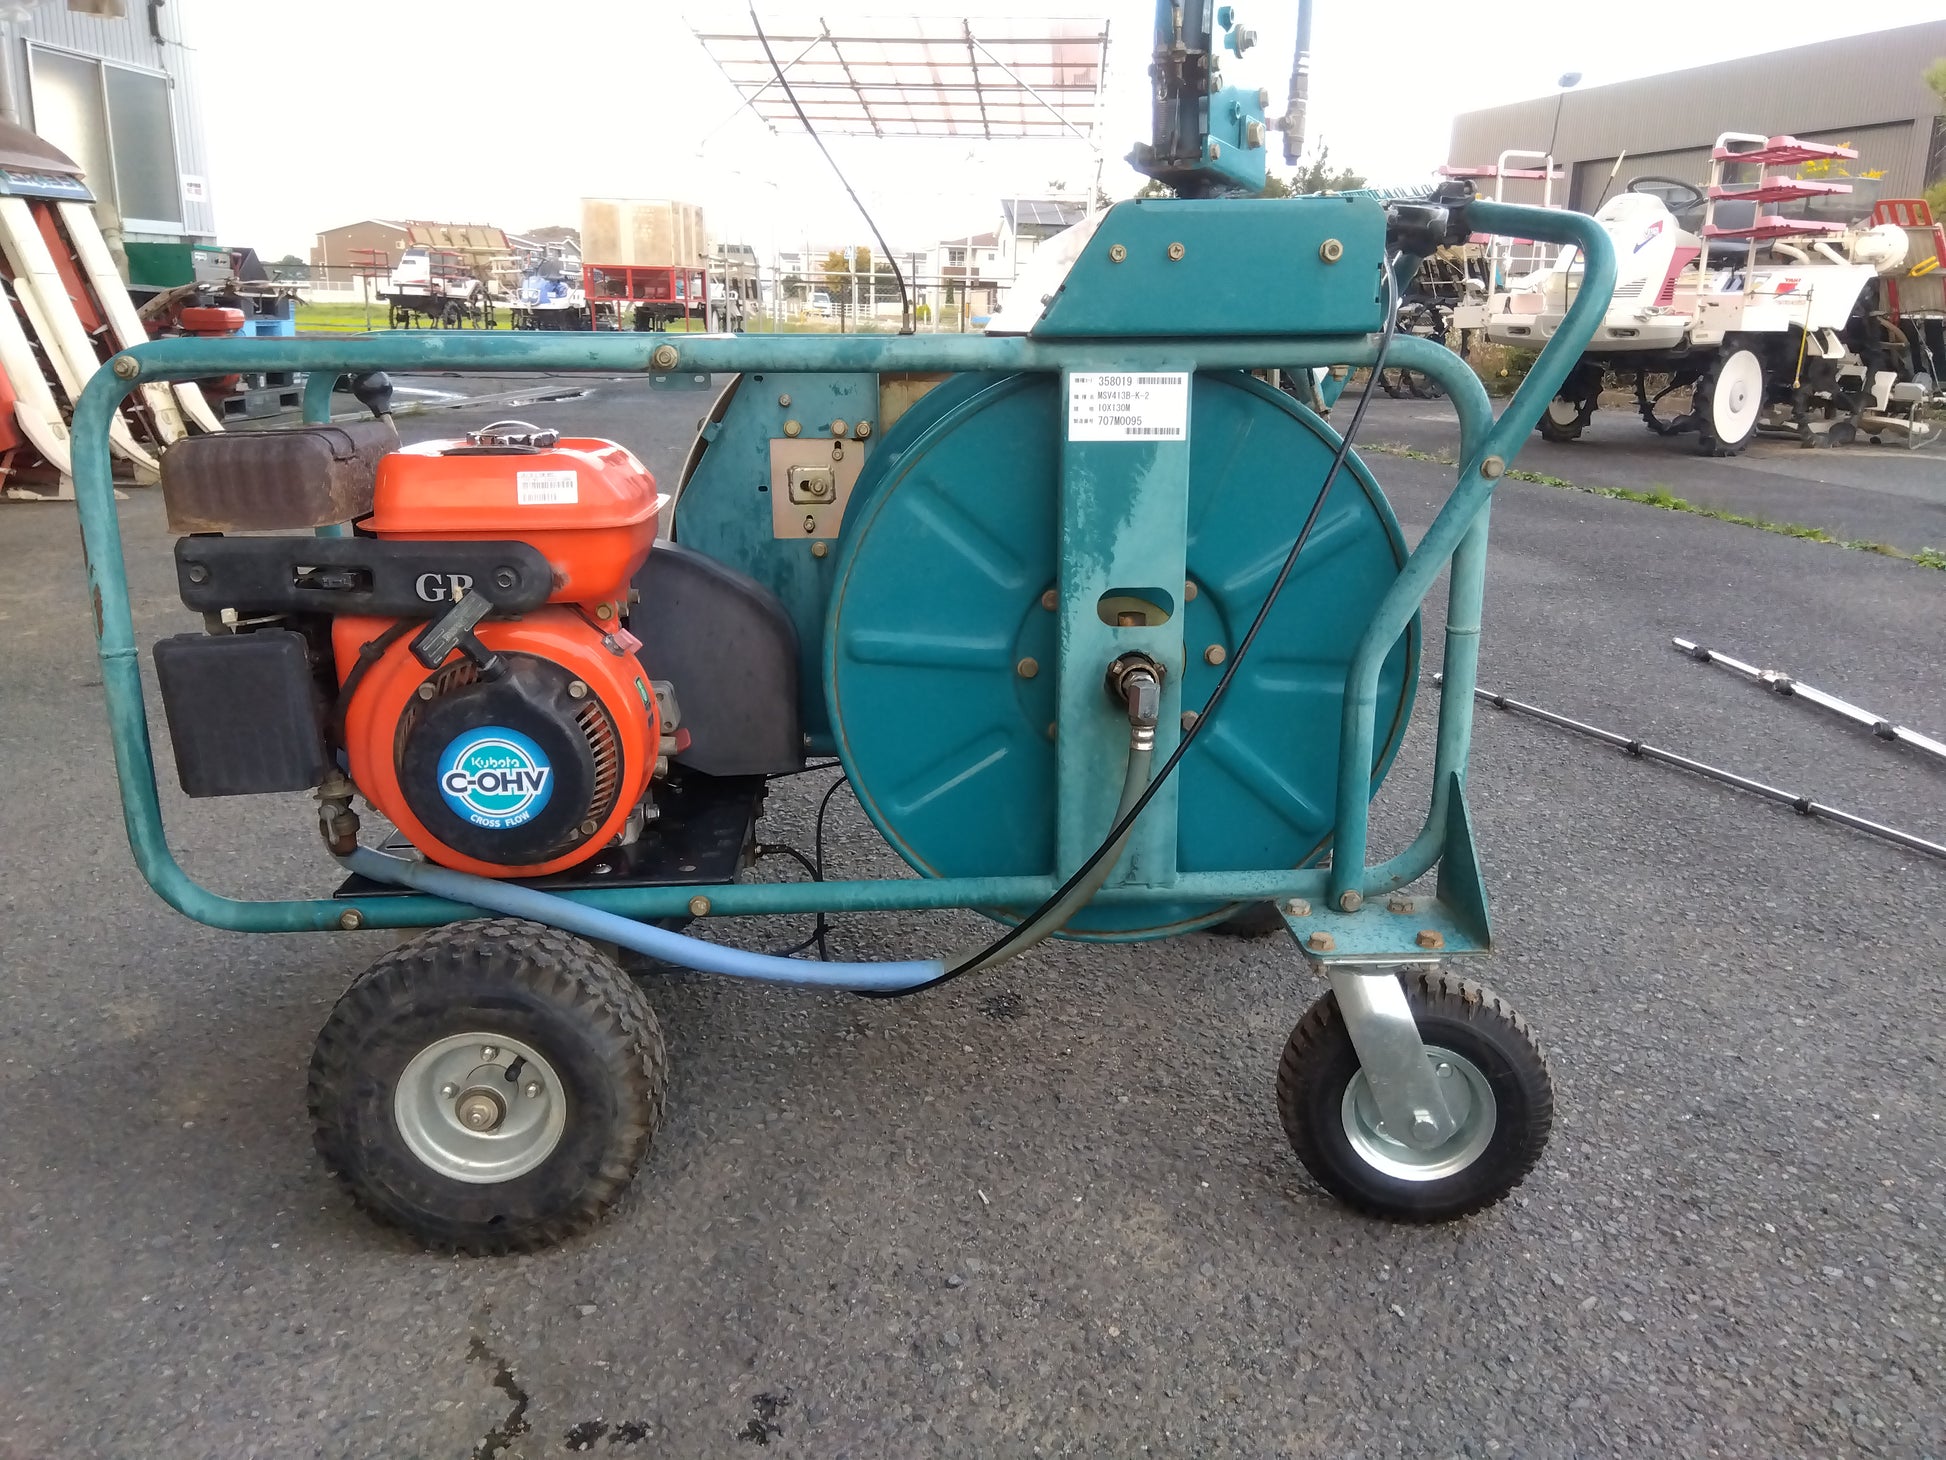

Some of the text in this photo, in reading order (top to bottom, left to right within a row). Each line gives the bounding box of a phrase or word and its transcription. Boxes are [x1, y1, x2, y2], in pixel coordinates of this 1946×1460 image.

[1098, 376, 1133, 387] 358019
[1097, 391, 1150, 400] MSV413B-K-2
[1097, 415, 1142, 426] 707M0095
[471, 756, 520, 769] Kubota
[444, 769, 547, 795] C-OHV
[470, 811, 531, 828] CROSS FLOW
